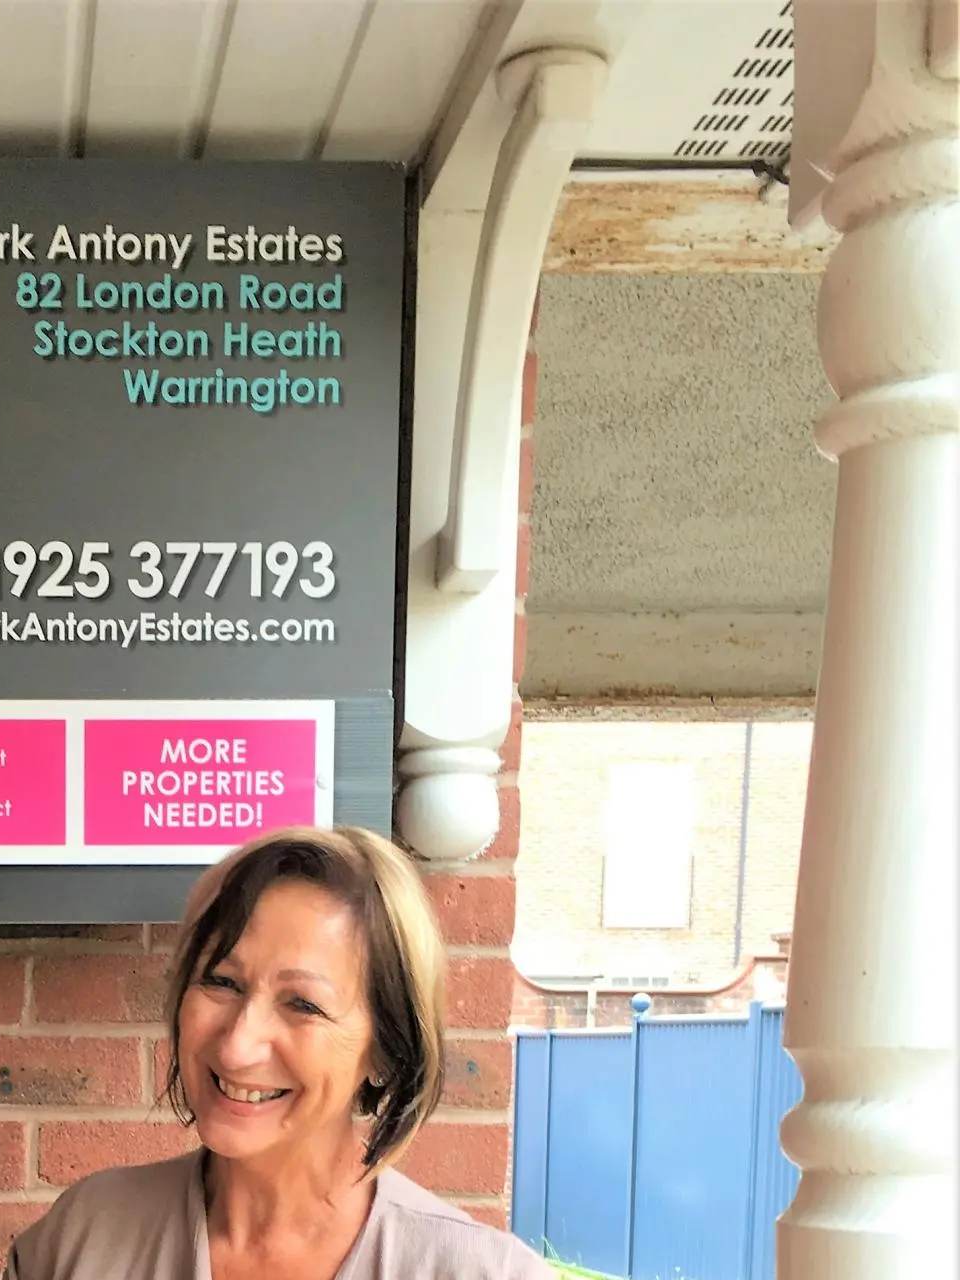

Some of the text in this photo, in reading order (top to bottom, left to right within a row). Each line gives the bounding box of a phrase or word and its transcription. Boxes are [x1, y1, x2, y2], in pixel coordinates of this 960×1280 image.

[47, 225, 192, 269] Antony
[207, 226, 342, 262] Estates
[16, 272, 342, 310] 82 London Road
[33, 320, 340, 356] Stockton Heath
[123, 368, 339, 413] Warrington
[127, 541, 336, 598] 377193
[160, 738, 247, 764] MORE
[122, 770, 285, 796] PROPERTIES
[143, 802, 263, 828] NEEDED!
